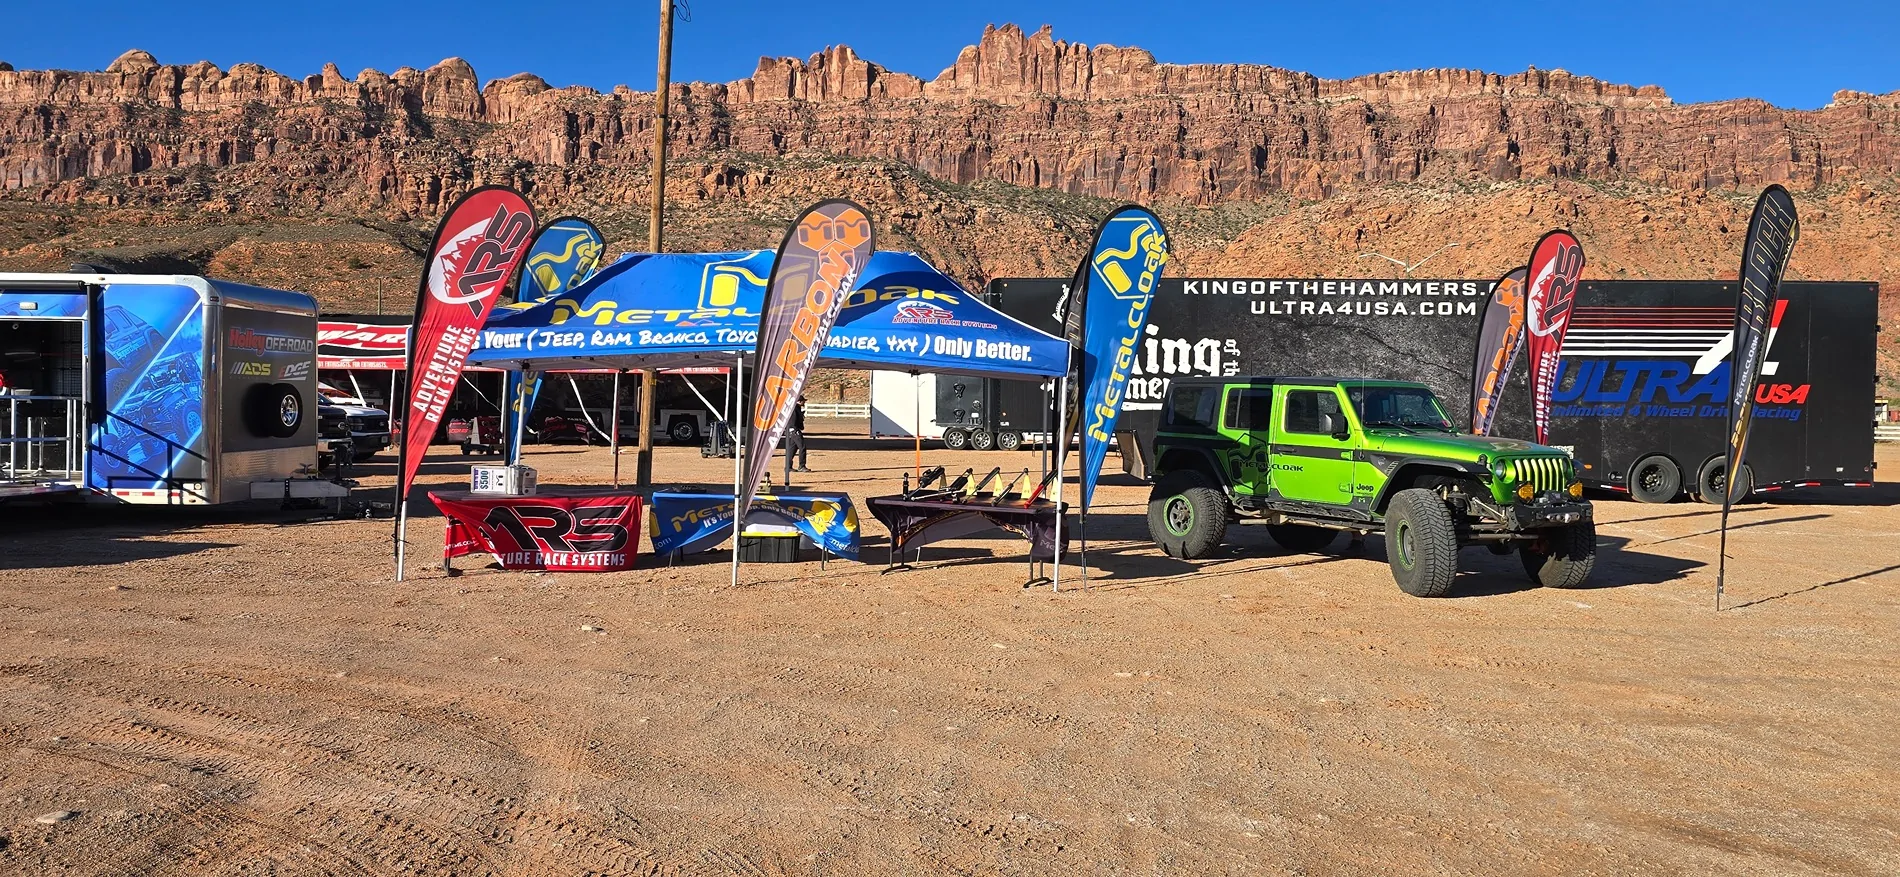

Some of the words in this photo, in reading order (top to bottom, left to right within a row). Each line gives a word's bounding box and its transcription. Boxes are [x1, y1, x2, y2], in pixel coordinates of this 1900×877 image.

[458, 203, 534, 319] ARS
[1183, 280, 1494, 296] KINGOFTHEHAMMERS.
[1543, 241, 1583, 346] ARS
[894, 306, 954, 320] ARS
[1250, 300, 1477, 316] ULTRA4USA.COM
[229, 326, 266, 356] Holley
[318, 329, 406, 344] WAR
[484, 330, 523, 349] Your
[716, 328, 759, 343] TOYO
[934, 335, 974, 358] Only
[975, 338, 1033, 362] Better.
[754, 247, 853, 432] CARBON
[278, 361, 311, 379] EDGE
[412, 324, 462, 413] ADVENTURE
[424, 387, 451, 423] RACK
[441, 326, 477, 386] SYSTEMS
[1222, 359, 1241, 377] th
[1535, 350, 1552, 428] ADVENTURE
[1755, 383, 1812, 405] USA
[768, 391, 797, 450] AXLES
[793, 368, 807, 394] BY
[1551, 404, 1626, 417] nlimited
[1629, 405, 1640, 417] 4
[1647, 404, 1694, 417] Wheel
[479, 470, 489, 490] $500
[1356, 483, 1374, 492] Jeep
[478, 505, 630, 553] ARS
[703, 515, 717, 529] It's
[716, 509, 736, 523] You
[534, 553, 569, 567] RACK
[571, 553, 626, 567] SYSTEMS
